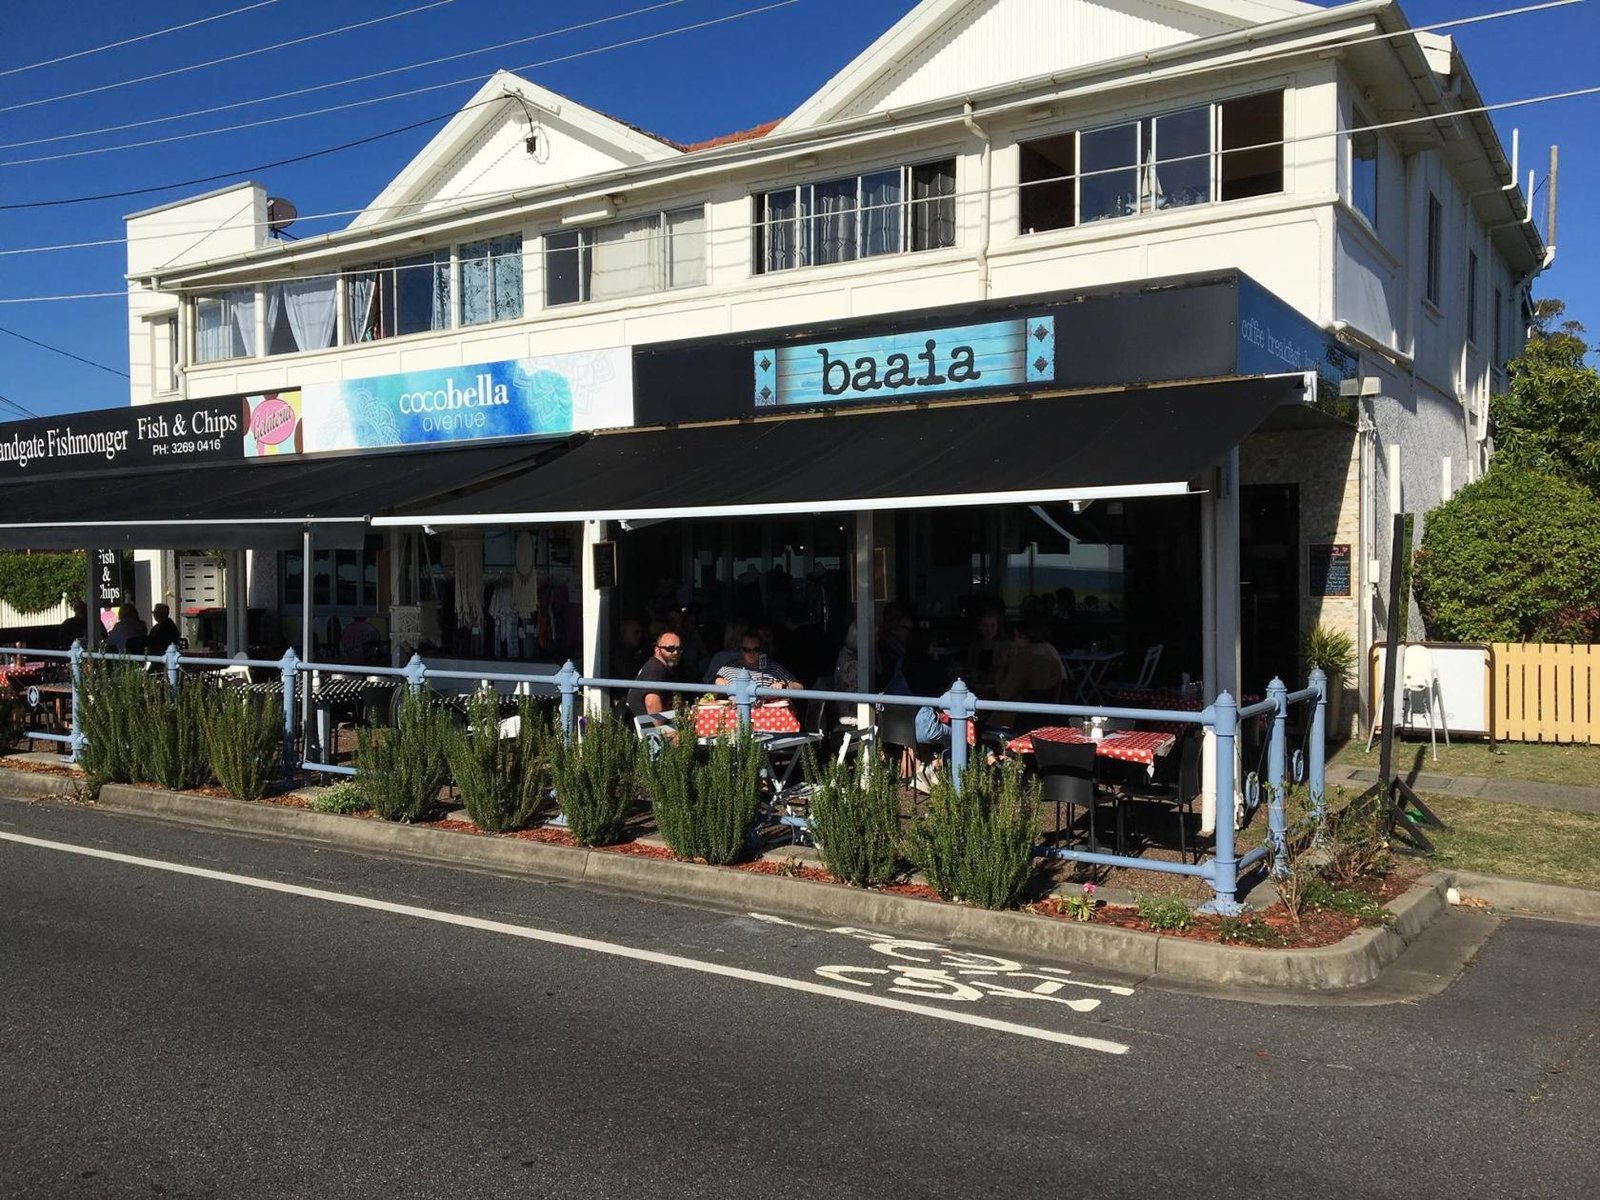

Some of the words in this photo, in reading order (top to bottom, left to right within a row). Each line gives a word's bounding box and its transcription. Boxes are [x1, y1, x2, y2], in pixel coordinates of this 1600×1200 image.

[817, 338, 981, 395] baaia
[399, 373, 510, 415] cocobella
[136, 414, 169, 441] Fish
[172, 413, 188, 437] &
[191, 408, 238, 438] Chips
[422, 411, 487, 432] avenue
[46, 426, 129, 460] Fishmonger
[152, 444, 169, 456] PH:
[171, 441, 195, 454] 3269
[197, 438, 221, 452] 0416
[101, 565, 112, 582] &
